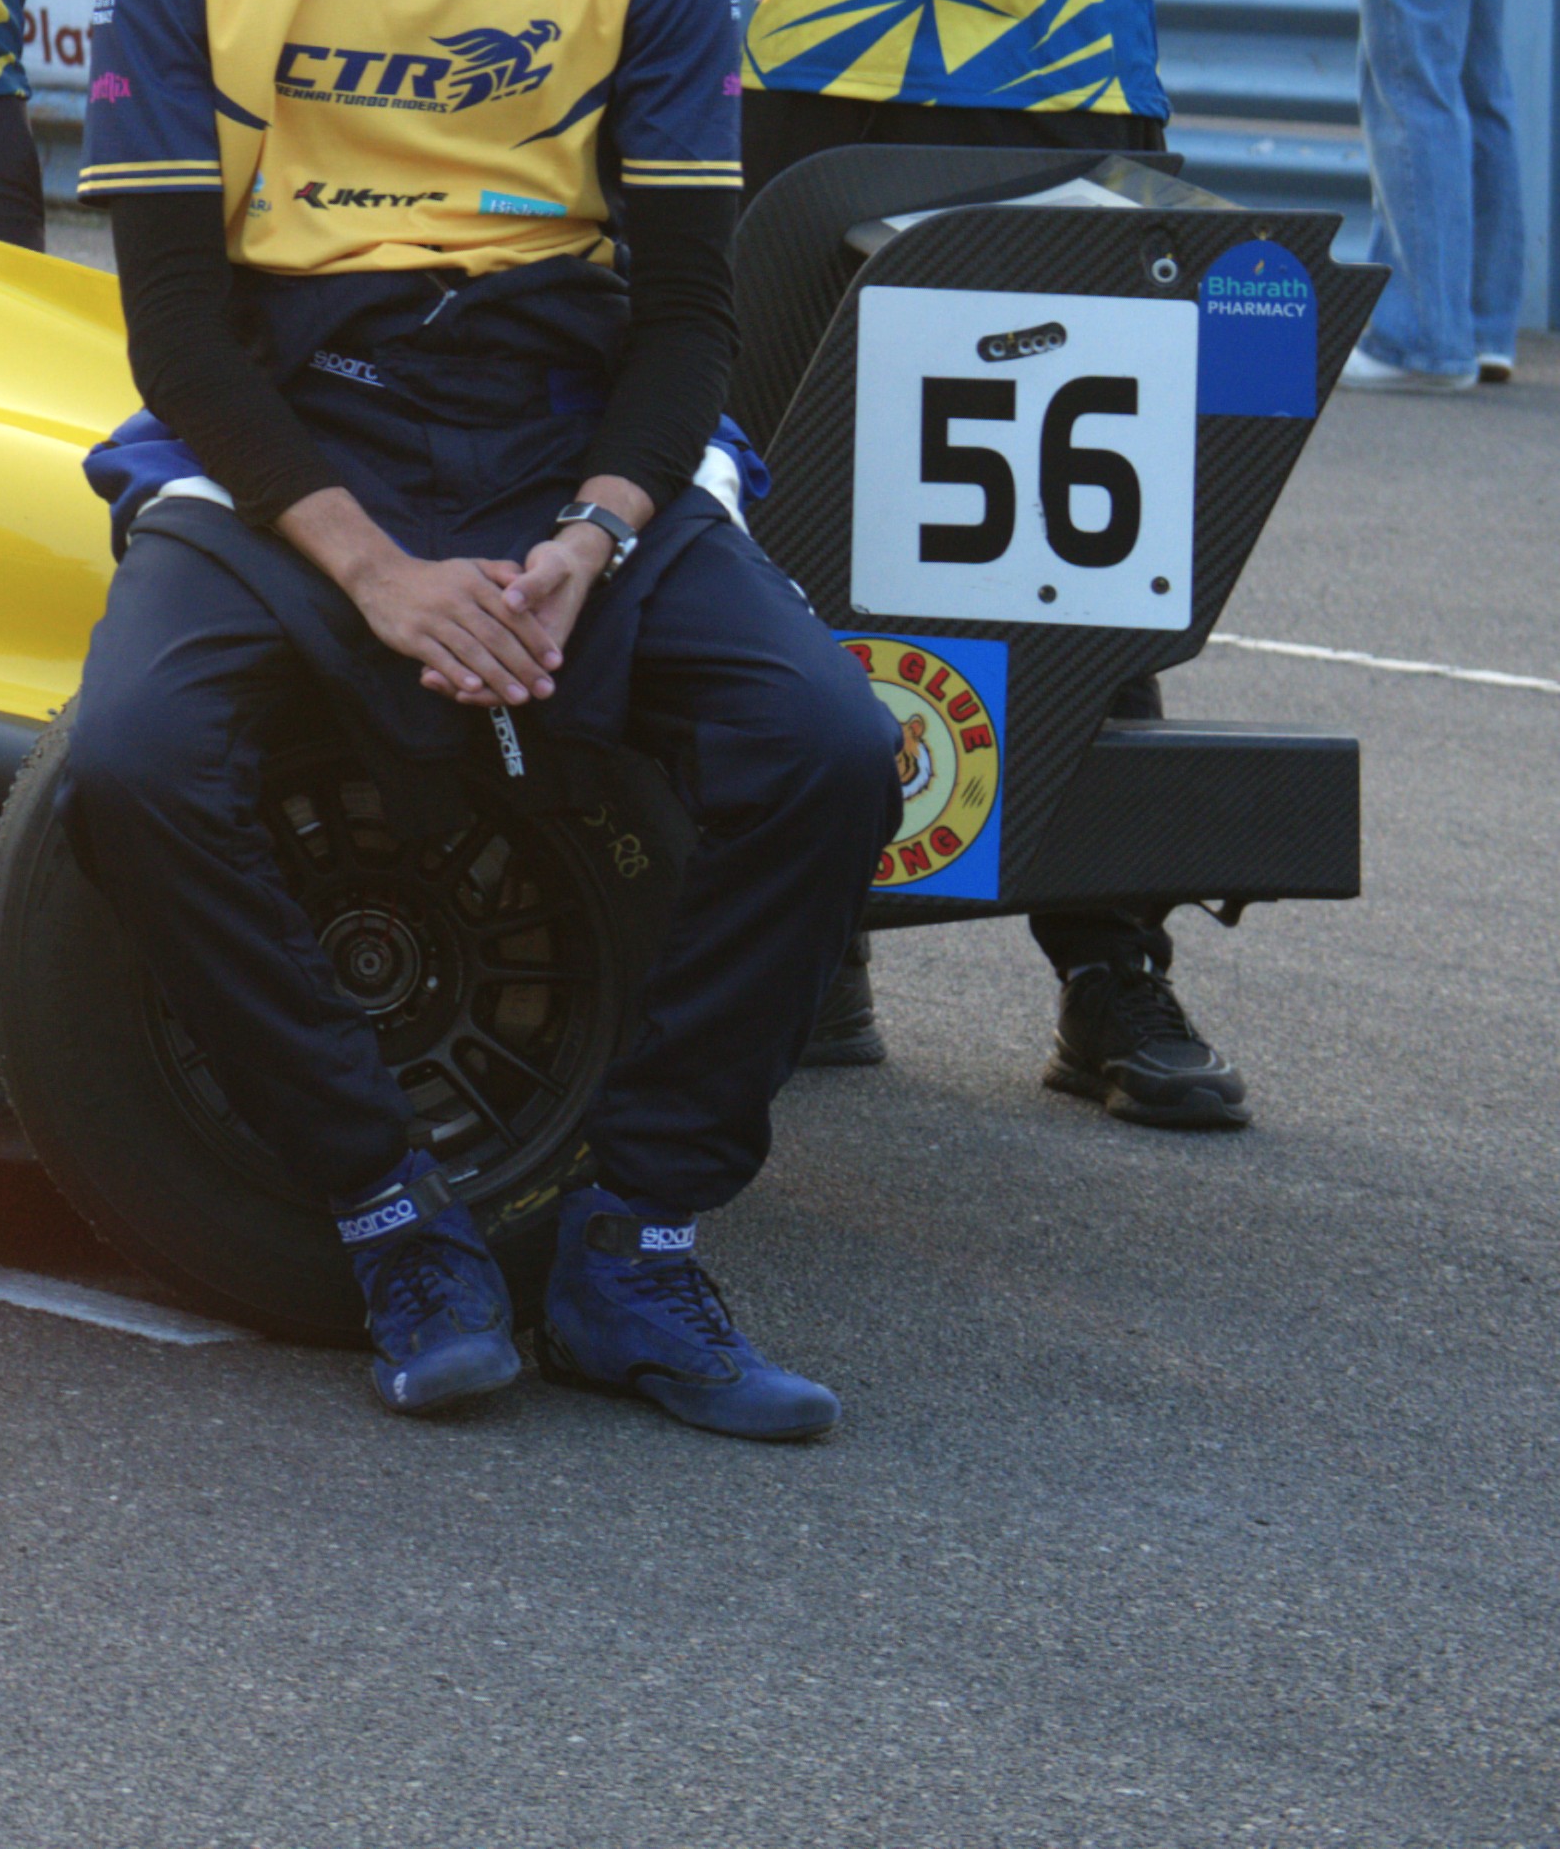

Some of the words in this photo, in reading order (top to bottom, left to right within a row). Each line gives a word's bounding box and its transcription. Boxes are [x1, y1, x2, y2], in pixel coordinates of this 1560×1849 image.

[23, 8, 94, 66] Pla
[275, 42, 452, 99] CTR
[335, 92, 390, 108] TURBO
[391, 98, 448, 113] RIDERS
[1207, 275, 1308, 301] Bharath
[1207, 301, 1306, 318] PHARMACY
[919, 375, 1143, 569] 56
[897, 651, 993, 754] GLUE
[874, 825, 964, 881] ONG
[336, 1198, 414, 1239] sparco
